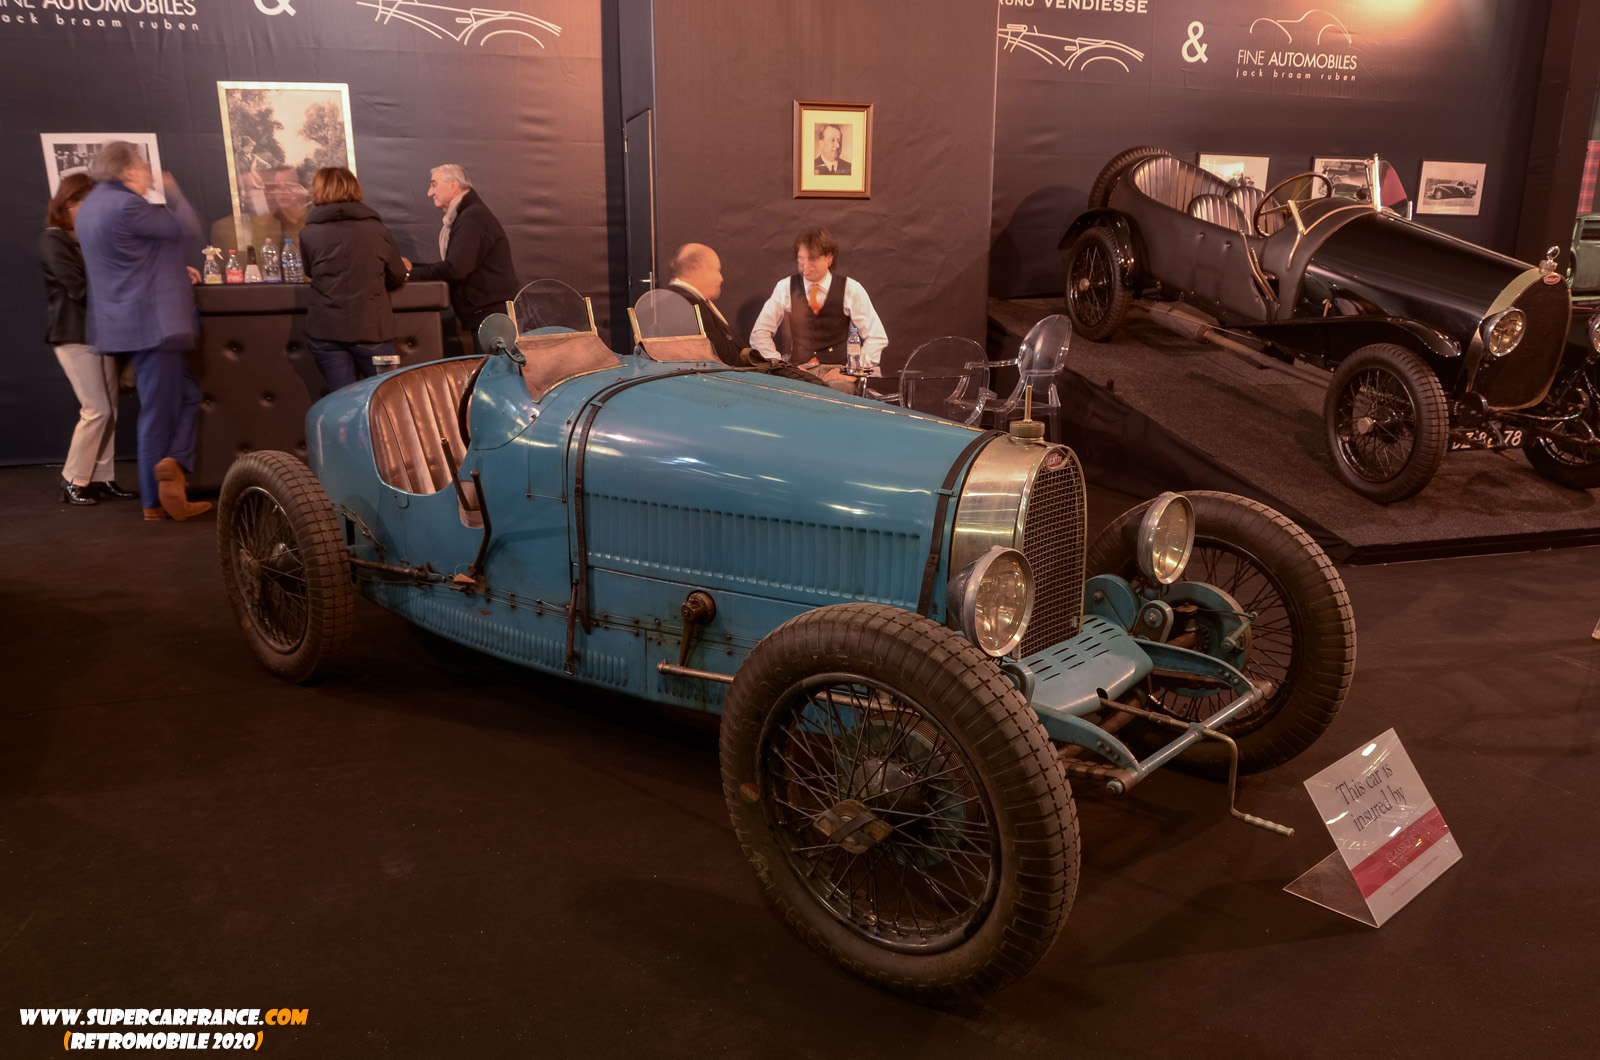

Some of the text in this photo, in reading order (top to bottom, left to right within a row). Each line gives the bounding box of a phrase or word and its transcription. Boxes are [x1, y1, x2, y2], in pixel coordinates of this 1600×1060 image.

[1045, 0, 1148, 13] VENDIESSE
[55, 13, 122, 28] braam
[139, 19, 199, 31] ruben
[1182, 20, 1208, 63] &
[1237, 49, 1358, 70] FINE AUTOMOBILES
[1236, 68, 1356, 82] jack braam ruben
[1335, 763, 1394, 805] This car is
[1350, 785, 1408, 832] insured by
